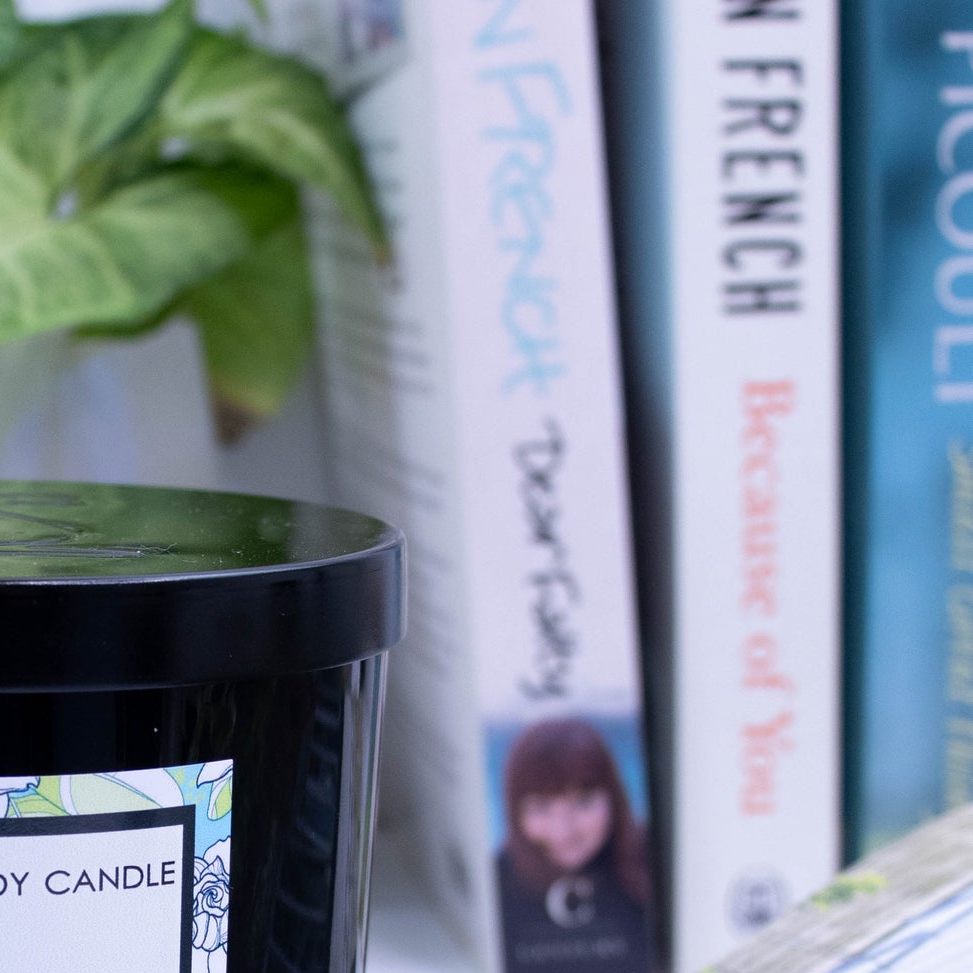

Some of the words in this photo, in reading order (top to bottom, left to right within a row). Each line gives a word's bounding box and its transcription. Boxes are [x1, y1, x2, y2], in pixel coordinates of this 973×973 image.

[720, 58, 805, 317] FRENCH
[741, 379, 795, 616] Because
[742, 634, 795, 693] of
[741, 710, 795, 817] You
[44, 860, 177, 896] CANDLE
